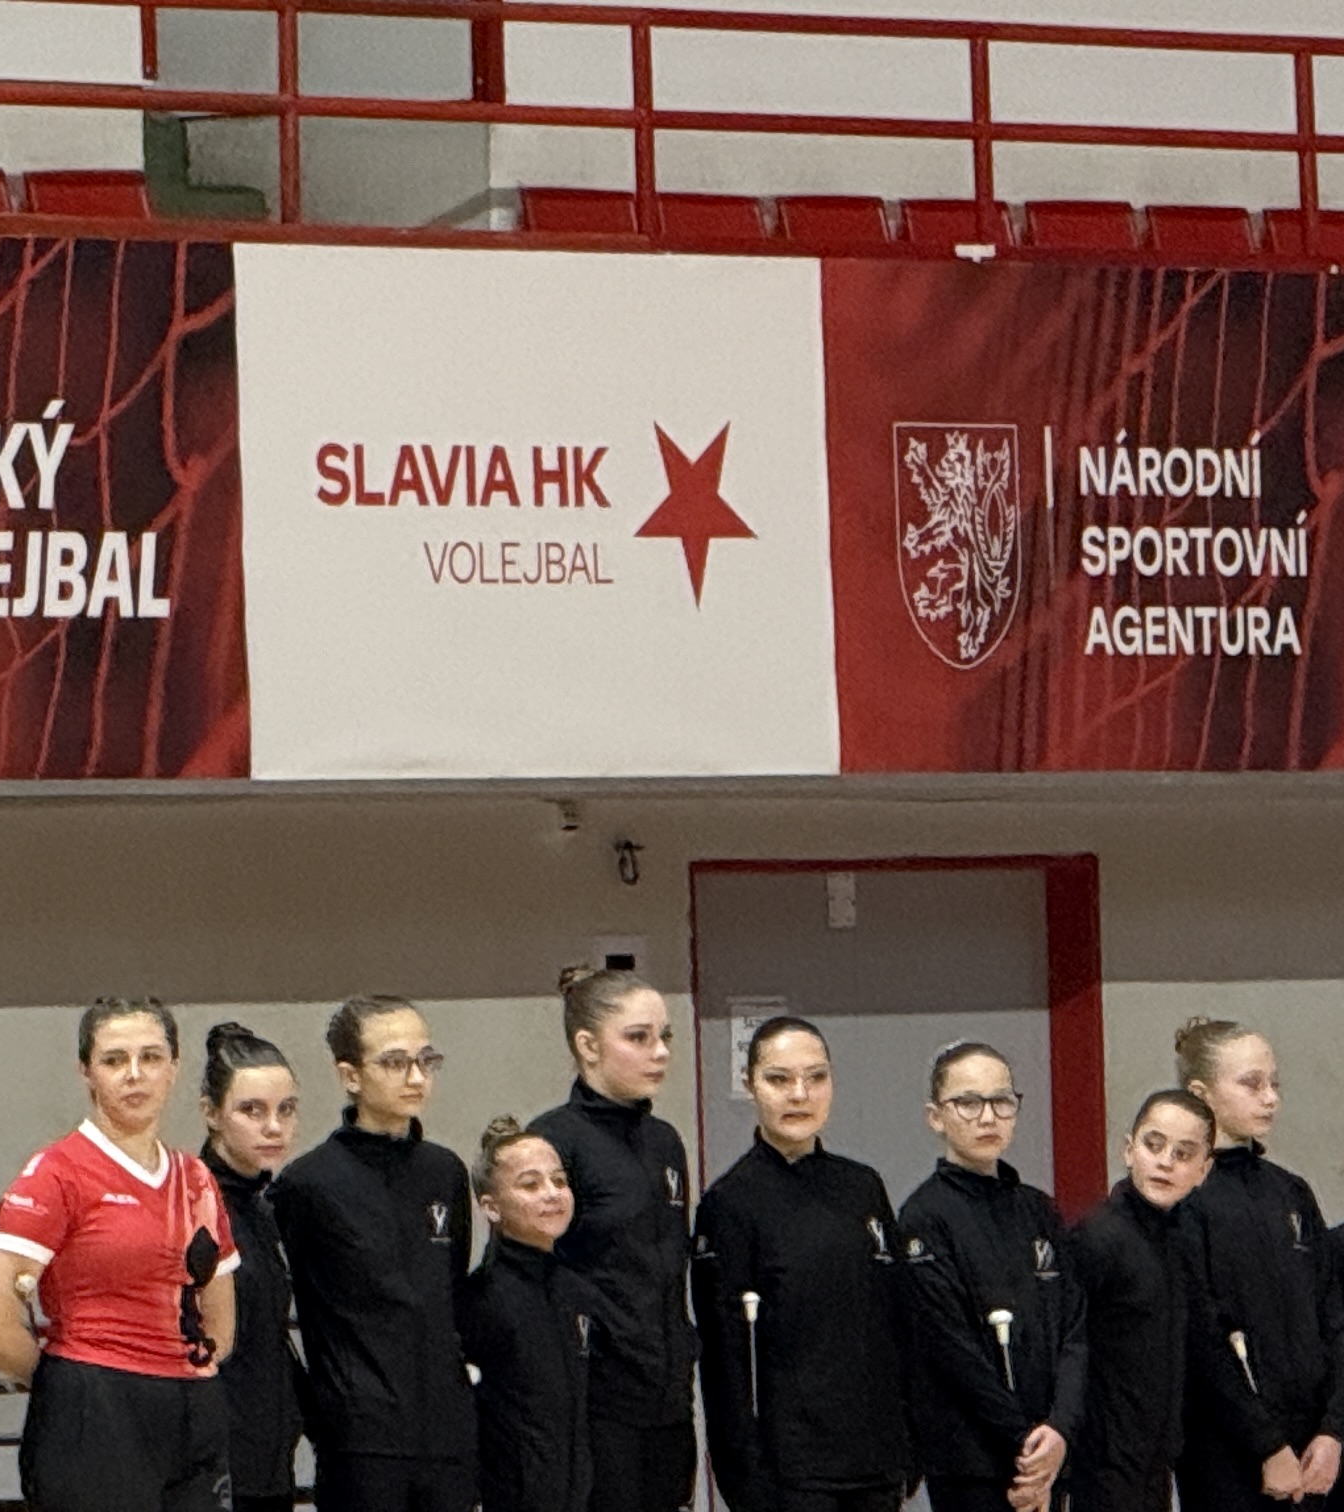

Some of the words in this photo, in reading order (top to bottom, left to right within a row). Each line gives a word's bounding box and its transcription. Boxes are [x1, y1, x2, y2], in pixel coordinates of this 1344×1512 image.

[316, 443, 520, 507] SLAVIA
[532, 446, 611, 508] HK
[1079, 428, 1262, 498] NÁRODNÍ
[424, 541, 614, 584] VOLEJBAL
[1081, 510, 1308, 577] SPORTOVNÍ
[1084, 605, 1302, 655] AGENTURA
